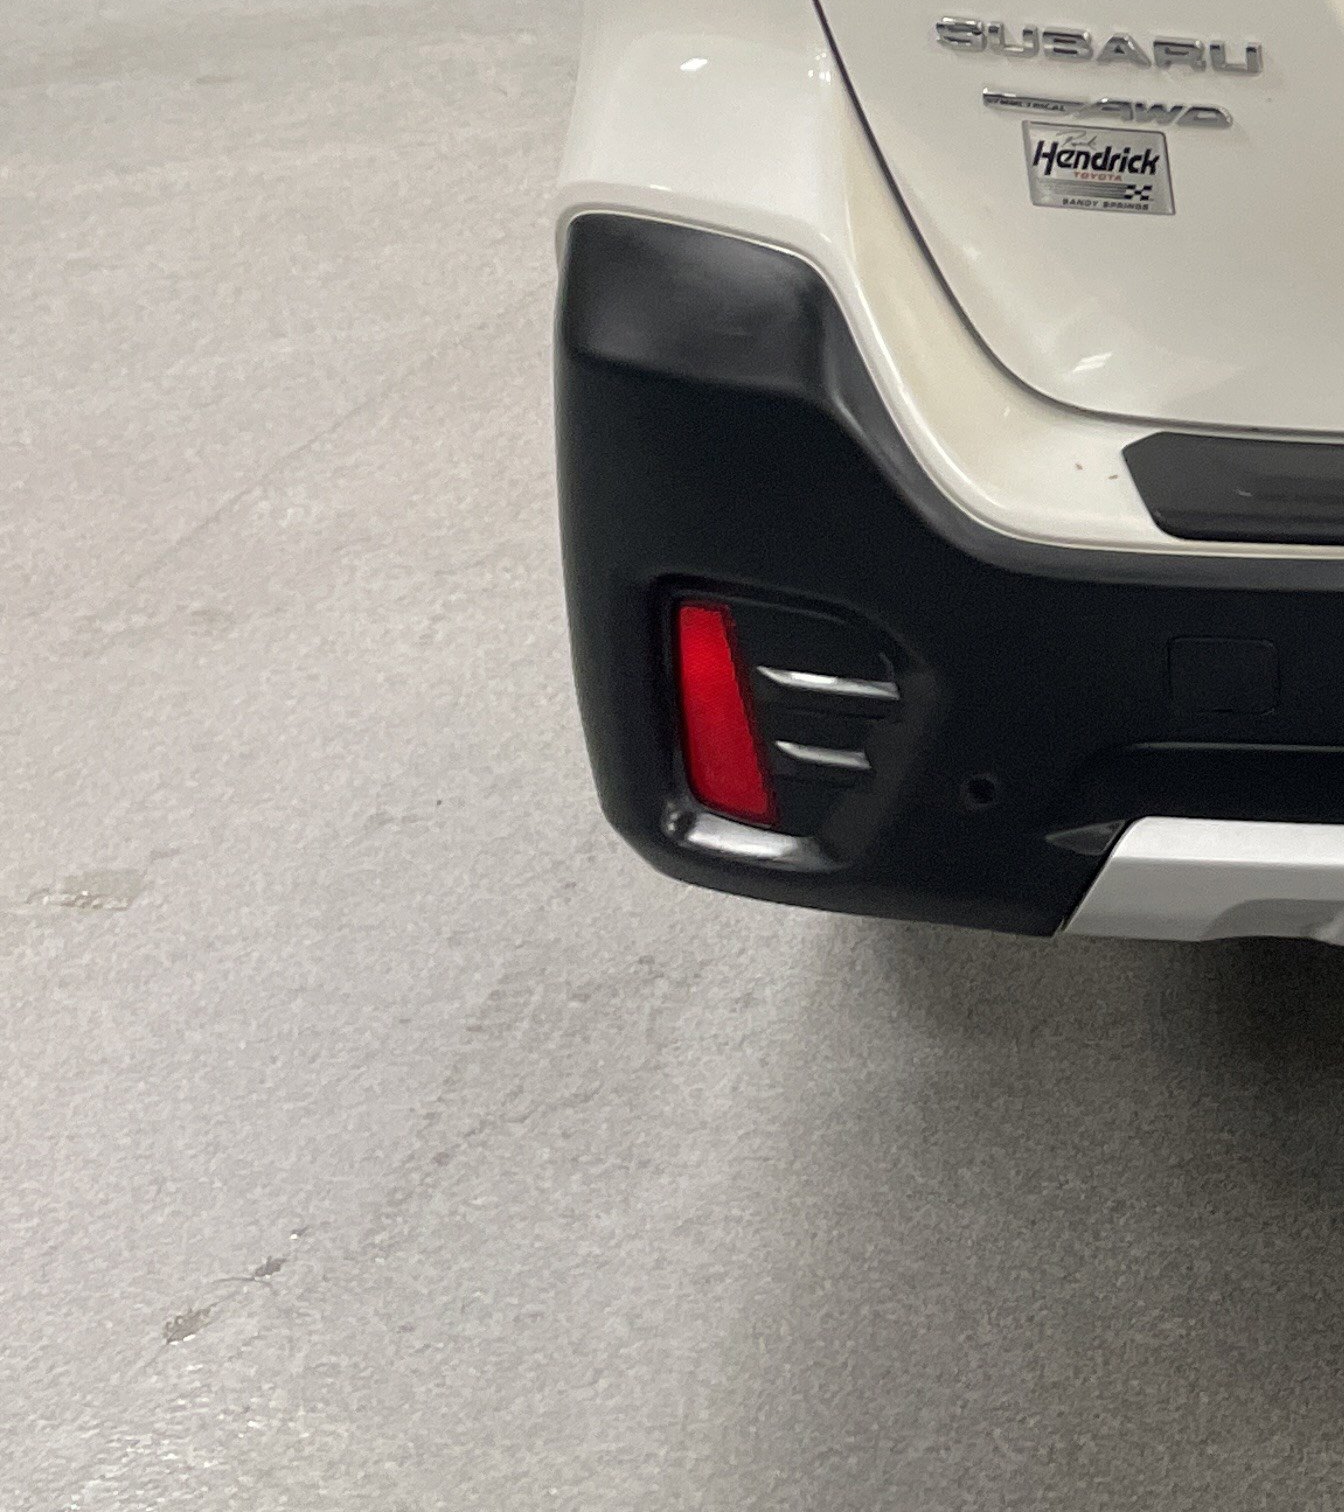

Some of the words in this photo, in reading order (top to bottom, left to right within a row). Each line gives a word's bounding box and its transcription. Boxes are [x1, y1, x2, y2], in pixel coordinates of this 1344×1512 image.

[935, 16, 1263, 77] SUBARU
[1080, 96, 1233, 128] AWD
[1032, 140, 1160, 176] Hendrick
[1073, 171, 1123, 182] TOYOTA
[1062, 198, 1099, 208] SANDY
[1102, 201, 1149, 211] SPRINGS
